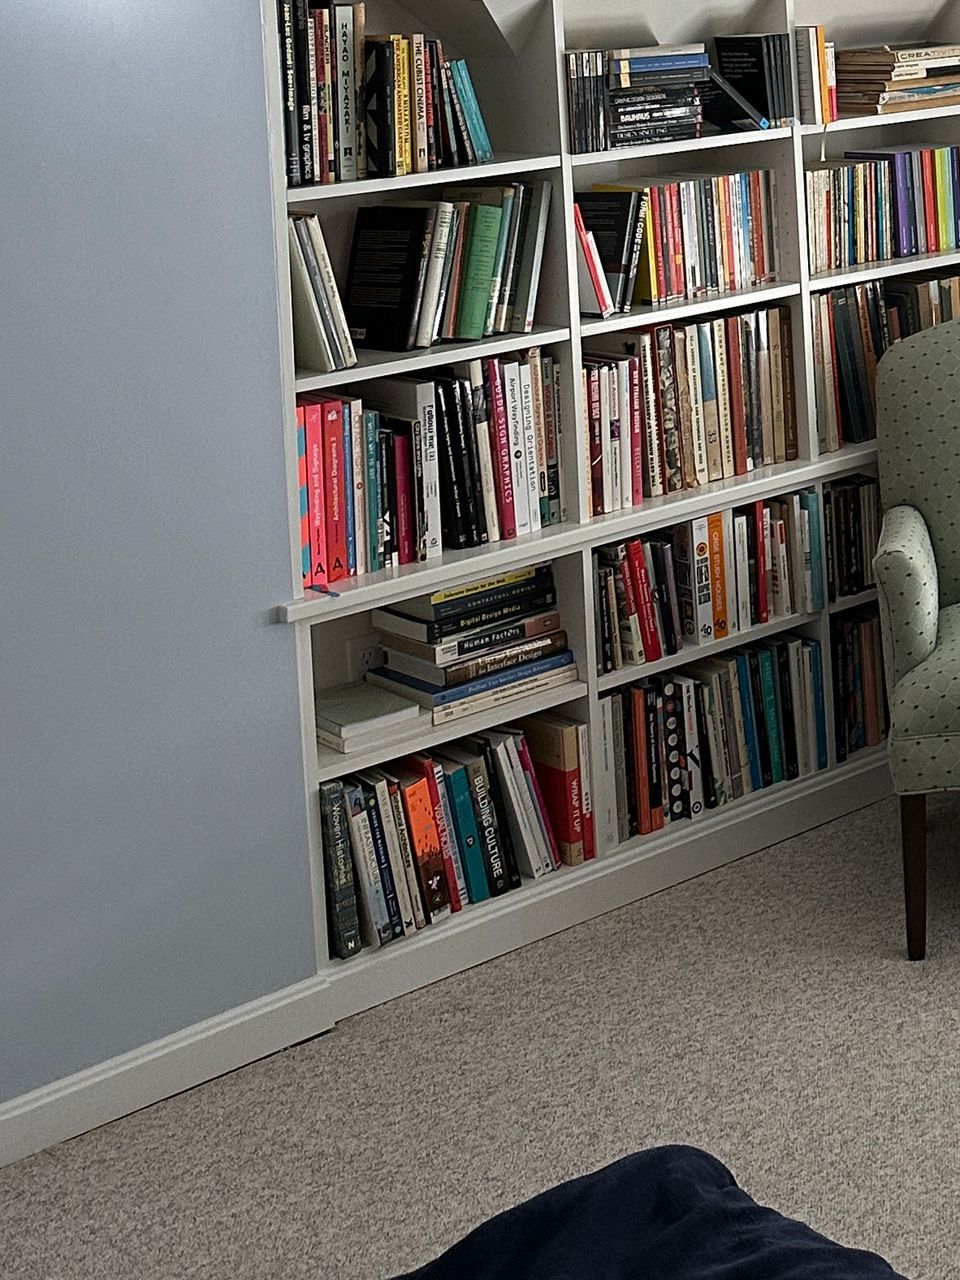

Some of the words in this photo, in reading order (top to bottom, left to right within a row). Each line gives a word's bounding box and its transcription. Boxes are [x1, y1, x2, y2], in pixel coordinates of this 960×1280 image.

[283, 3, 292, 37] Jean-Luc
[285, 38, 294, 68] Godard:
[341, 23, 349, 62] HAYAO
[416, 58, 424, 86] CUBIST
[302, 105, 311, 120] film
[342, 70, 350, 134] MIYAZAKI
[416, 87, 425, 120] CINEMA
[303, 133, 312, 141] tv
[303, 144, 312, 180] graphics
[640, 195, 649, 218] FORM
[634, 222, 644, 244] CODE
[494, 379, 506, 412] GUIDE
[509, 378, 518, 403] Airport
[533, 364, 541, 403] Architectural
[545, 383, 553, 412] WORDS
[522, 384, 532, 431] Designing
[498, 417, 508, 445] SIGN
[510, 405, 522, 447] Wayfinding
[707, 430, 717, 444] 33
[428, 435, 435, 449] me
[536, 439, 545, 467] Graphics
[329, 443, 338, 476] Diagrams
[526, 434, 537, 492] Orientation
[500, 448, 513, 504] GRAPHICS
[313, 488, 322, 526] Wayfinding
[331, 477, 339, 521] Architectural
[465, 585, 479, 594] Design
[467, 592, 510, 607] CONTEXTUAL
[627, 586, 636, 613] COUPLAND
[715, 579, 723, 611] HOUSES
[460, 617, 481, 627] Digital
[481, 610, 502, 620] Design
[503, 605, 521, 614] Media
[463, 636, 489, 649] Human
[491, 628, 520, 641] Factors
[487, 659, 517, 671] Interface
[518, 650, 542, 662] Design
[571, 779, 579, 808] WRAP
[331, 803, 342, 839] Woven
[434, 803, 446, 832] VISUAL
[474, 775, 492, 826] BUILDING
[484, 827, 503, 878] CULTURE
[572, 808, 580, 818] IT
[573, 819, 581, 833] UP
[391, 792, 404, 828] Behavioral
[398, 828, 412, 869] Architecture
[335, 839, 347, 885] Histories
